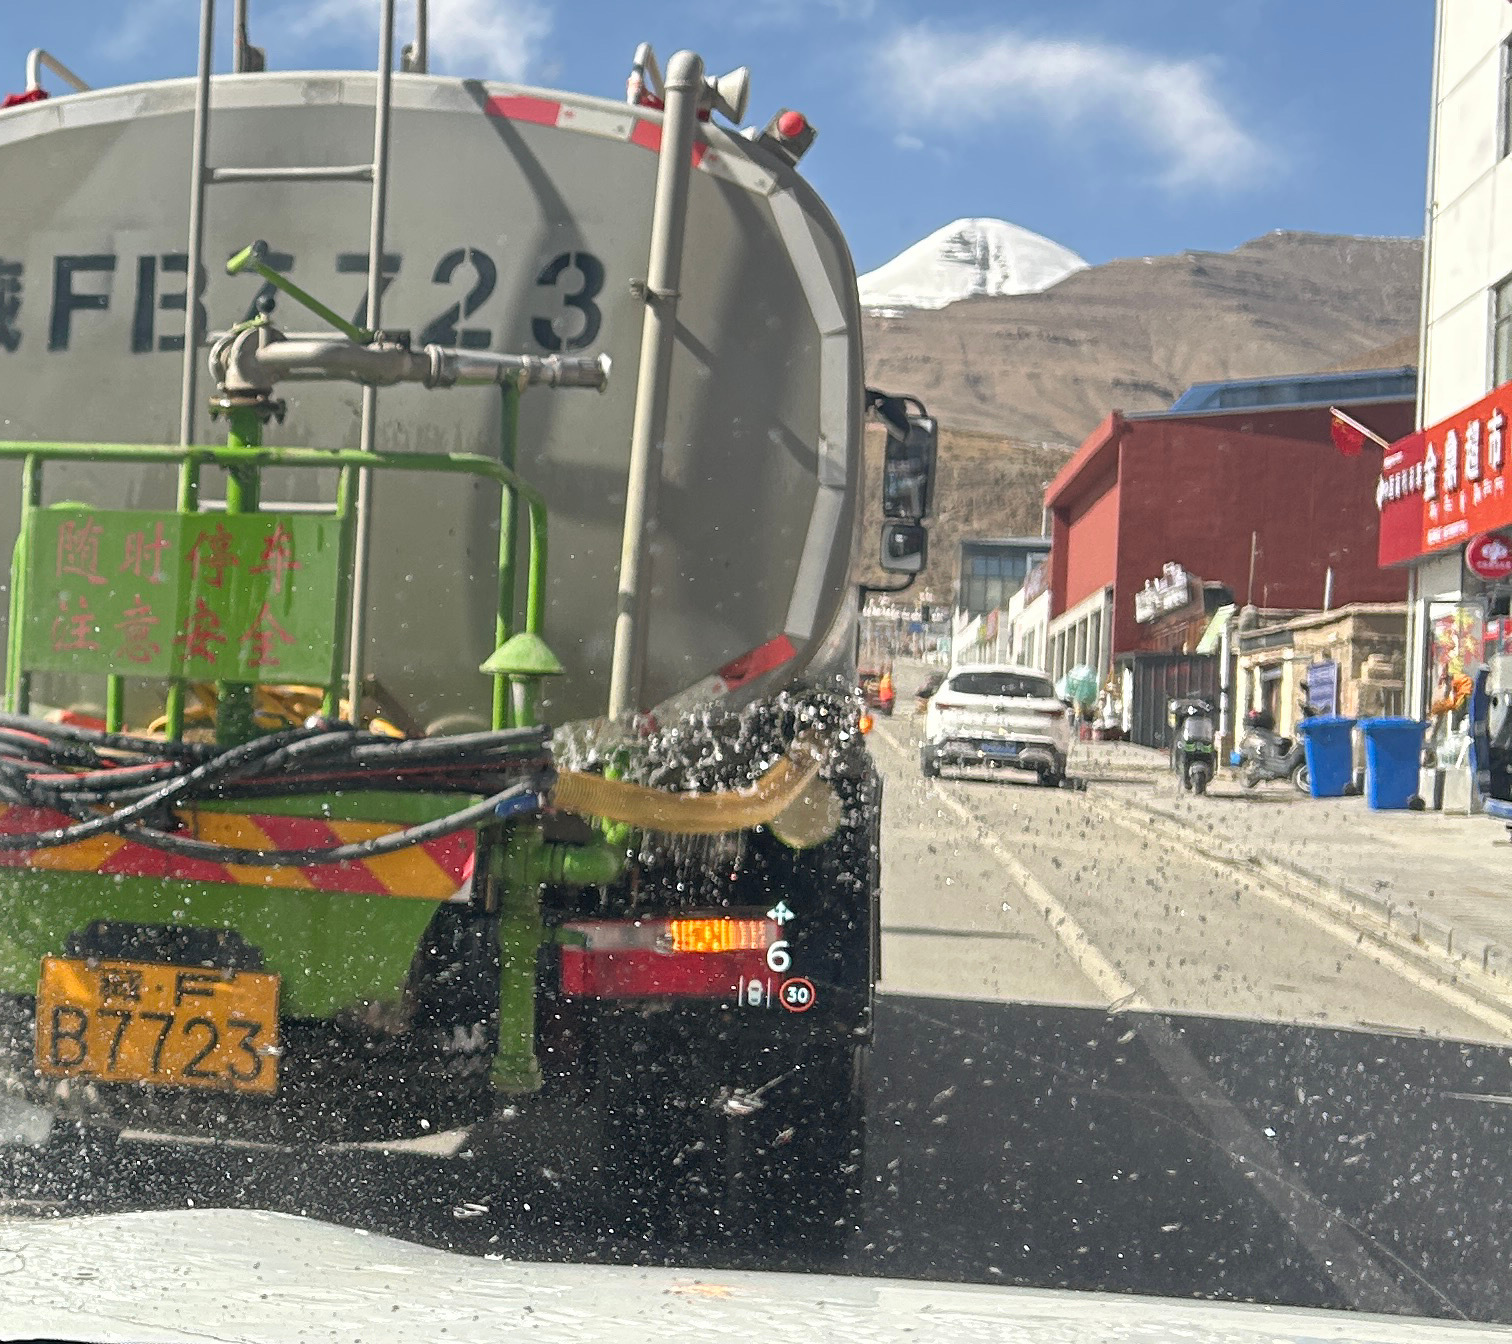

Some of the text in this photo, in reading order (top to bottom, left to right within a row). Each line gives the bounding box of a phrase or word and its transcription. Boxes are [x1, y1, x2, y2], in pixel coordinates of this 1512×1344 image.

[55, 517, 303, 594] 随时停车
[53, 594, 297, 669] 注意安全
[766, 940, 792, 973] 6
[786, 985, 809, 1004] 30
[51, 1006, 264, 1082] B7723
